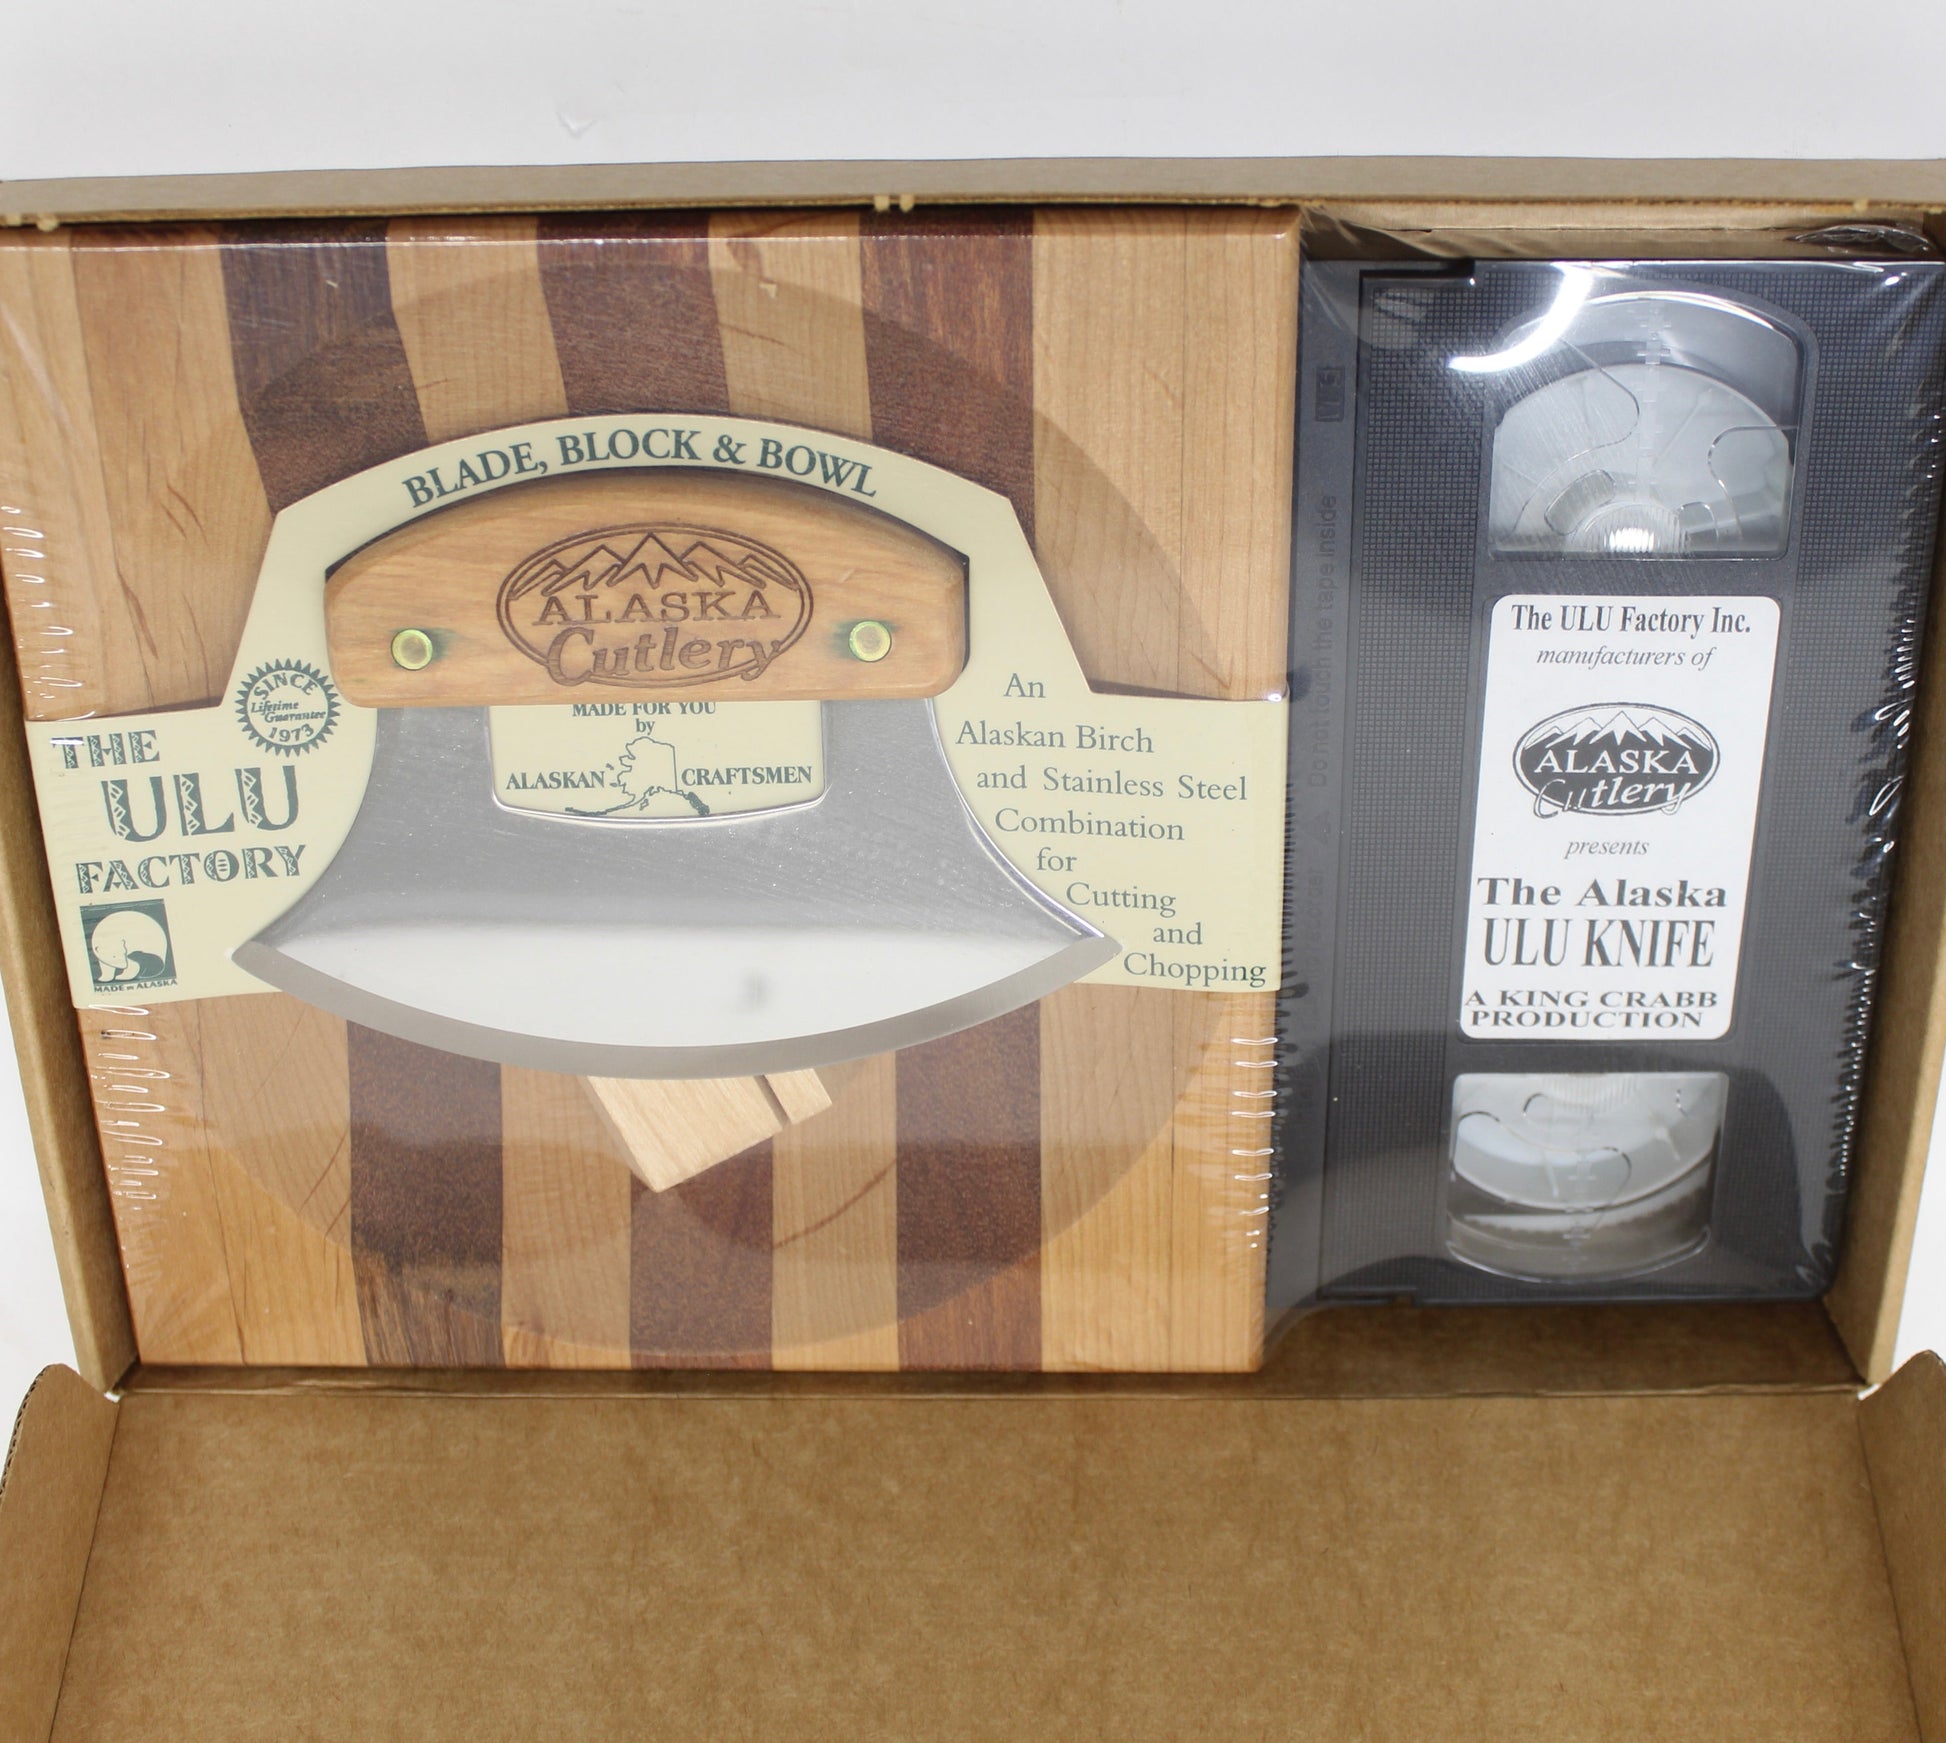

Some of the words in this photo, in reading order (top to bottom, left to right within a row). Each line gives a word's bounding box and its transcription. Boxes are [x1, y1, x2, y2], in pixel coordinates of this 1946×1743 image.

[402, 442, 548, 508] BLADE,
[557, 428, 702, 467] BLOCK
[713, 434, 747, 465] &
[756, 438, 878, 497] BOWL
[1315, 494, 1337, 557] inside
[1315, 562, 1338, 611] tape
[532, 590, 782, 626] ALASKA
[1511, 604, 1552, 630] The
[1559, 605, 1613, 632] ULU
[1620, 606, 1705, 639] Factory
[1710, 607, 1751, 633] Inc.
[1312, 617, 1333, 648] the
[547, 626, 782, 686] Cutlery
[1536, 645, 1686, 670] manufacturers
[1691, 647, 1717, 671] of
[253, 672, 318, 700] SINCE
[1003, 673, 1046, 698] An
[1311, 657, 1331, 714] touch
[251, 700, 299, 715] Lifetime
[264, 711, 326, 723] Guarantee
[572, 703, 626, 717] MADE
[633, 702, 671, 715] FOR
[679, 702, 717, 714] YOU
[268, 723, 314, 742] 1973
[635, 718, 655, 735] by
[955, 720, 1066, 748] Alaskan
[1075, 724, 1154, 753] Birch
[1310, 719, 1329, 754] not
[50, 730, 160, 769] THE
[1534, 750, 1699, 774] ALASKA
[506, 771, 605, 790] ALASKAN
[681, 766, 812, 786] CRAFTSMEN
[976, 765, 1027, 789] and
[1043, 766, 1164, 798] Stainless
[1178, 774, 1248, 800] Steel
[101, 765, 299, 842] ULU
[1533, 777, 1692, 819] Cutlery
[995, 808, 1185, 840] Combination
[1036, 847, 1077, 872] for
[1564, 840, 1650, 860] presents
[76, 844, 306, 894] FACTORY
[1066, 882, 1176, 918] Cutting
[1477, 877, 1562, 906] The
[1575, 878, 1727, 907] Alaska
[1152, 922, 1203, 945] and
[1484, 918, 1572, 966] ULU
[1581, 919, 1715, 968] KNIFE
[1123, 952, 1267, 988] Chopping
[94, 985, 124, 993] MADE
[136, 979, 178, 989] ALASKA
[1465, 990, 1487, 1006] A
[1499, 990, 1589, 1007] KING
[1600, 991, 1718, 1008] CRABB
[1471, 1010, 1705, 1029] PRODUCTION
